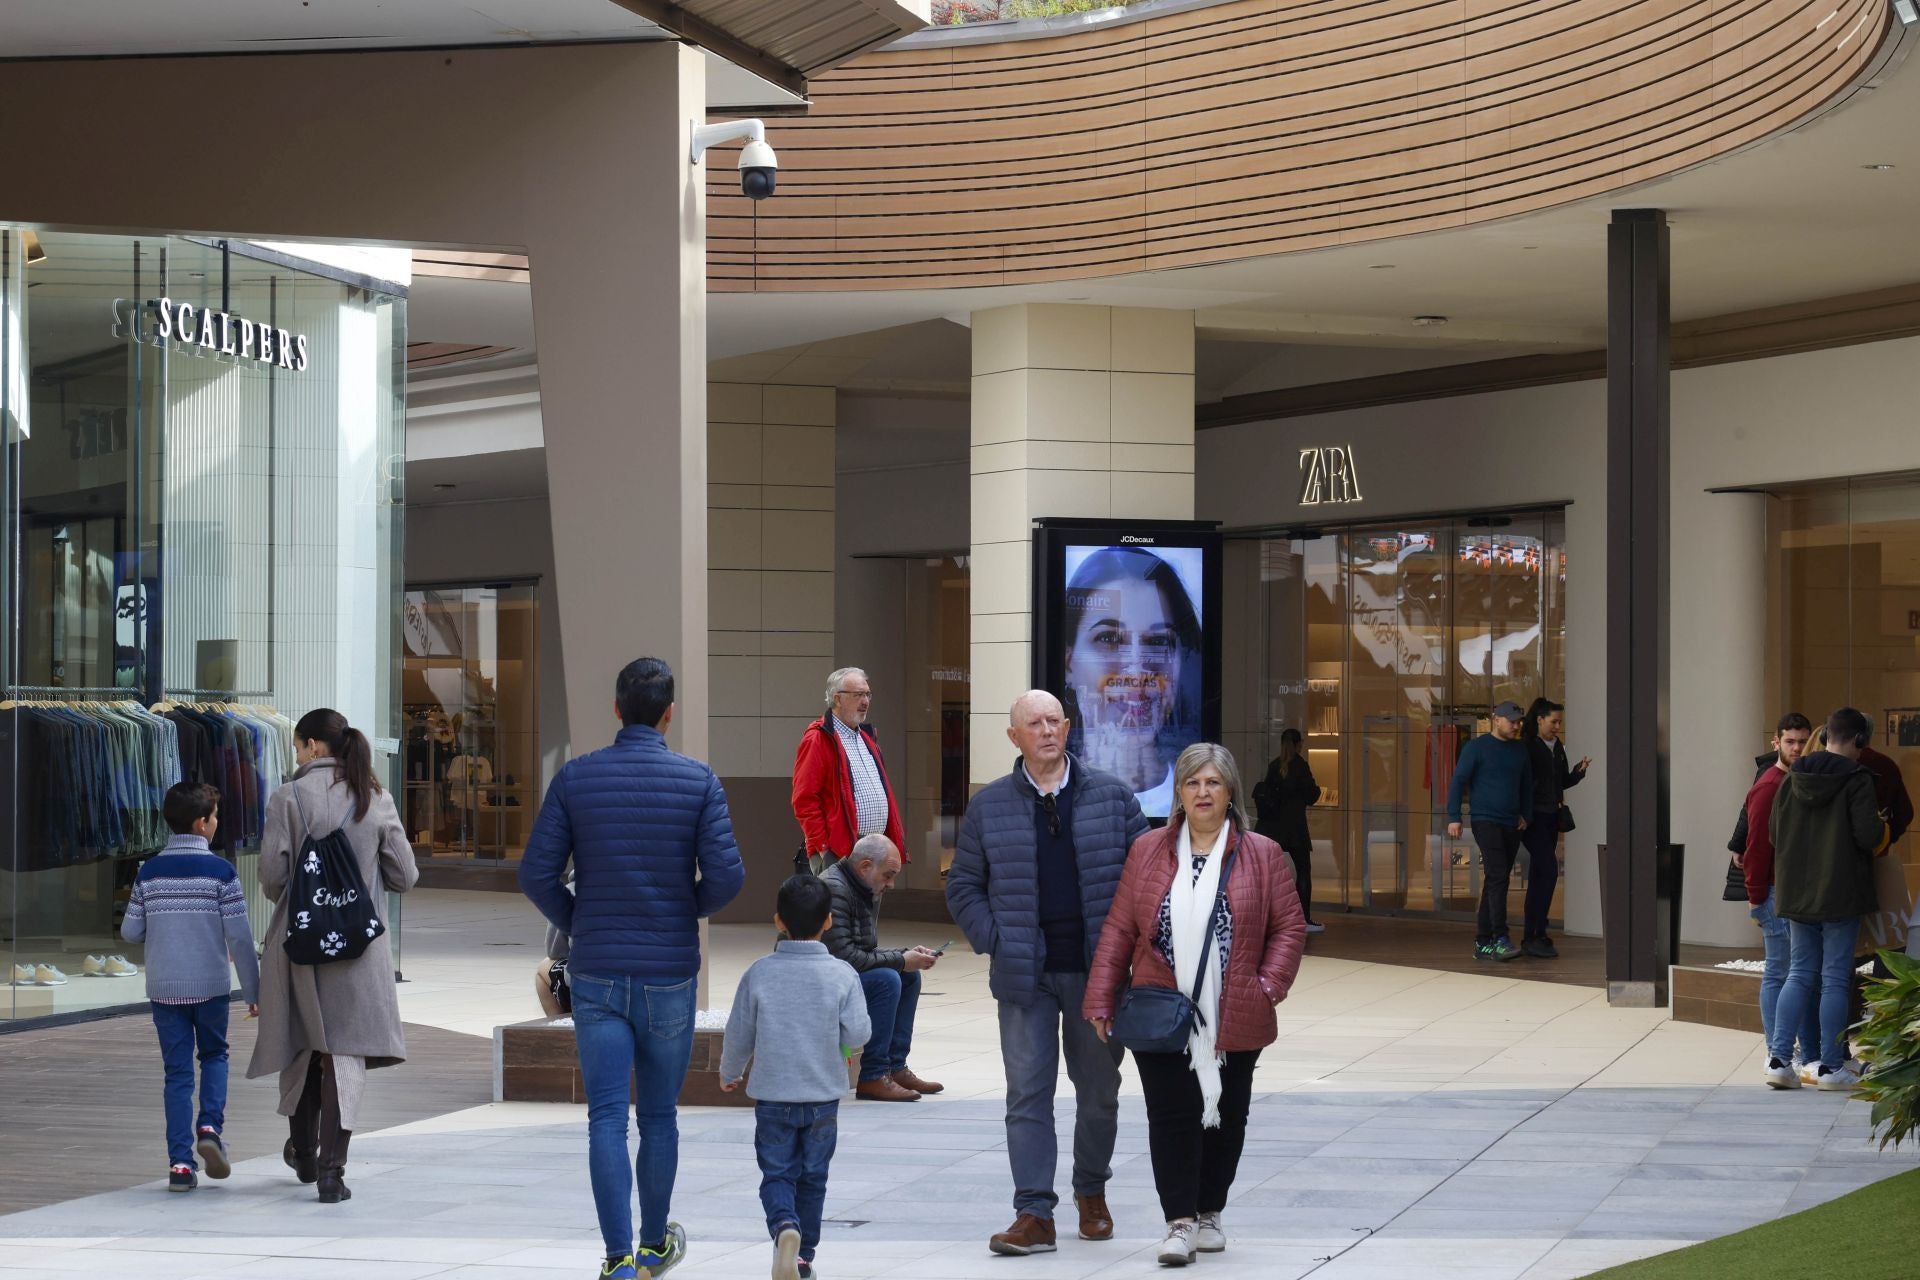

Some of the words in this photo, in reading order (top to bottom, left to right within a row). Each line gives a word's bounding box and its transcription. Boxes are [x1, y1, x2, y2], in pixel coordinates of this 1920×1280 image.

[158, 297, 307, 372] SCALPERS
[1299, 444, 1363, 505] ZARA
[1120, 535, 1155, 544] JCDecaux
[1066, 593, 1111, 607] onaire
[1106, 678, 1157, 688] GRACIAS
[312, 887, 358, 908] Enric
